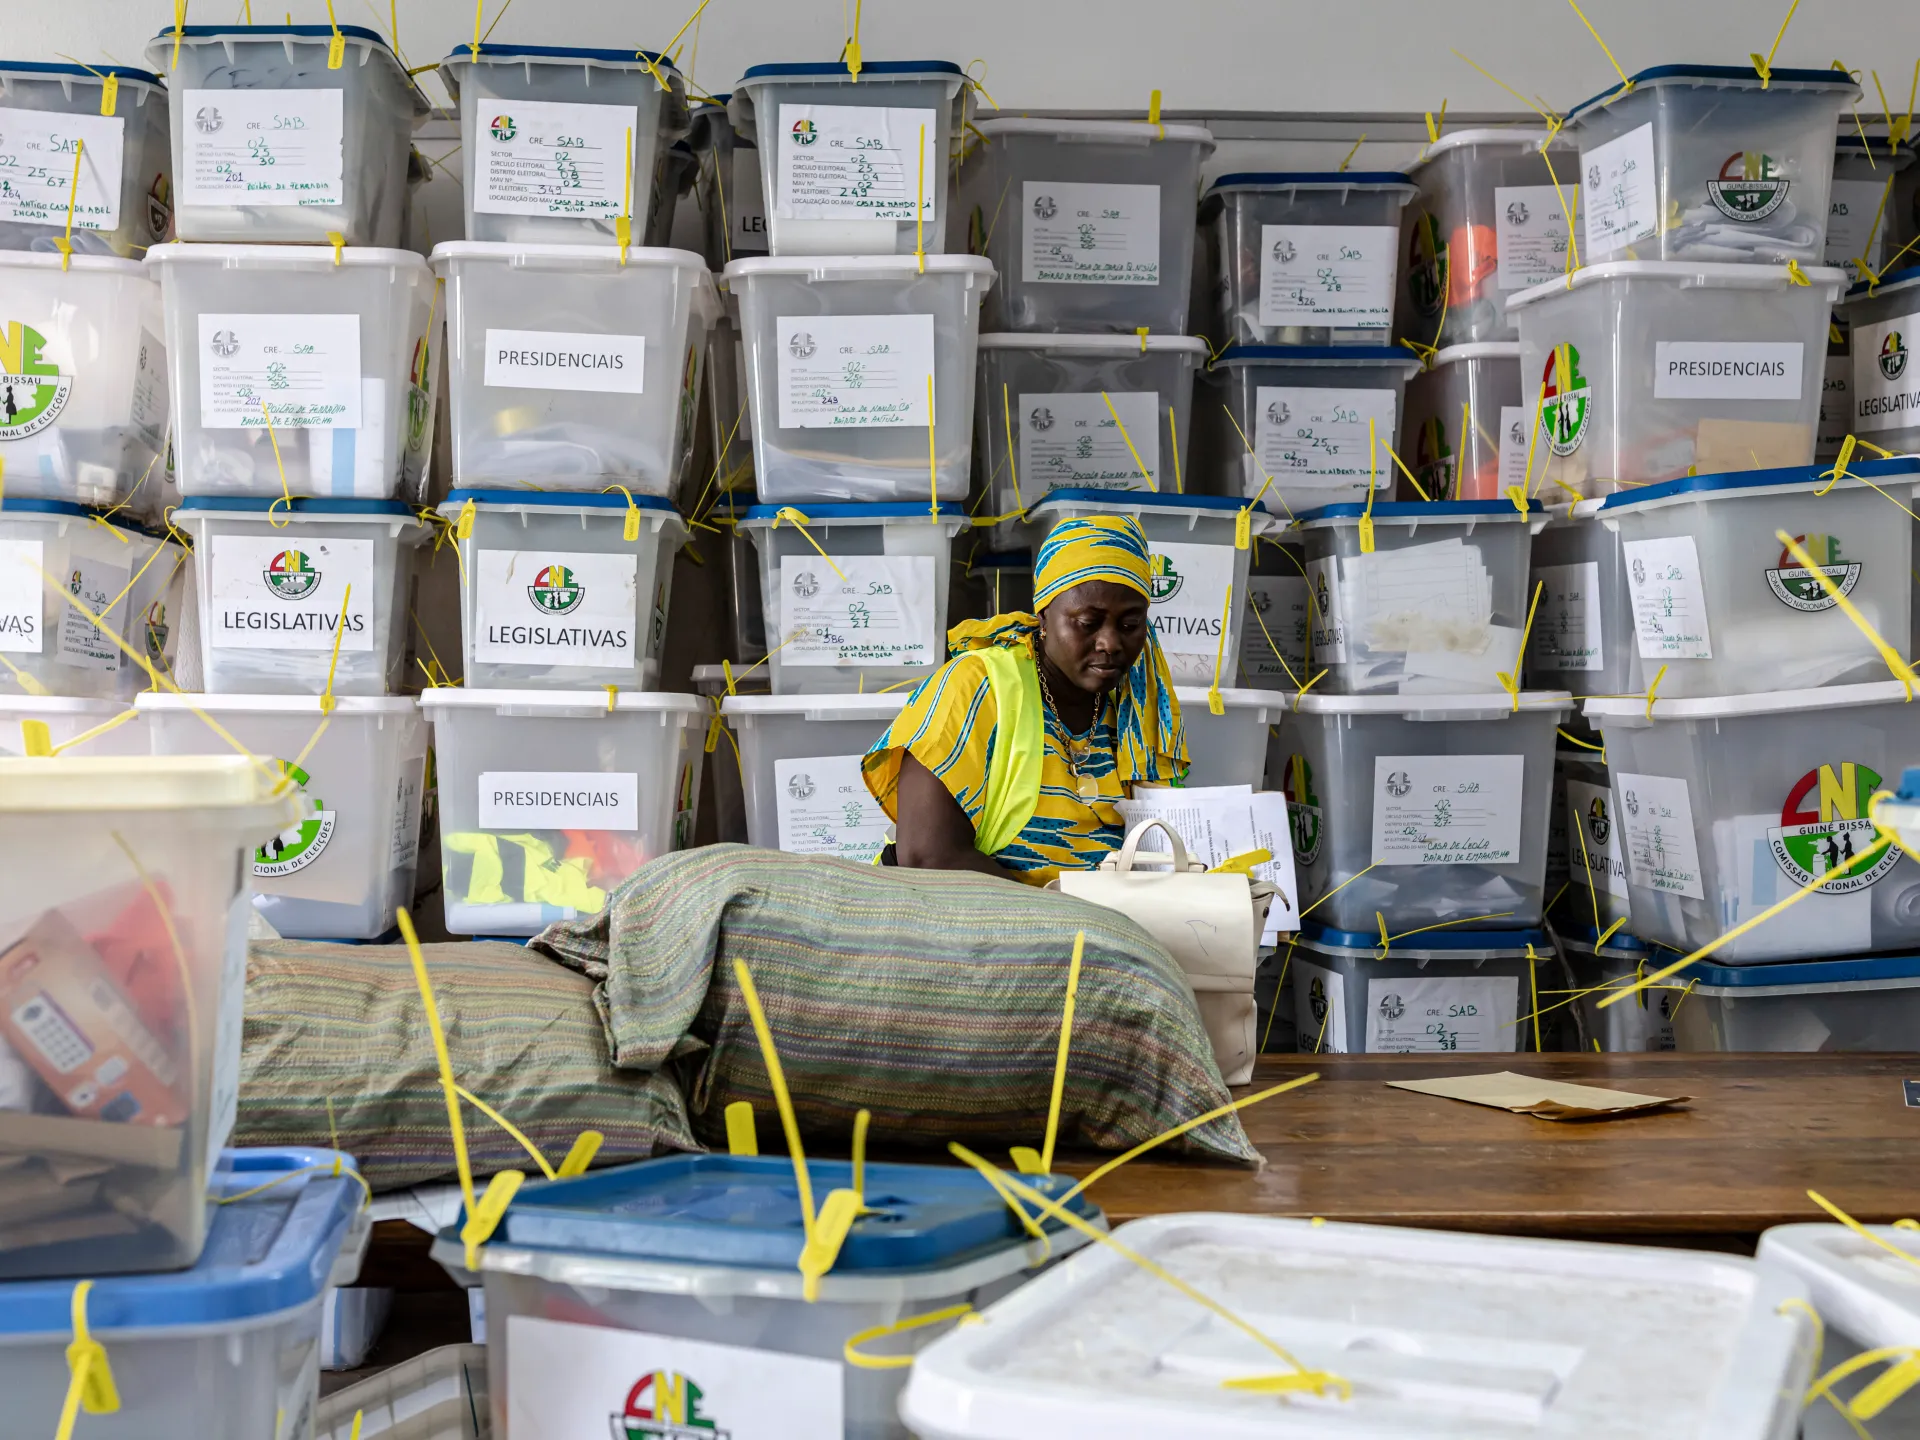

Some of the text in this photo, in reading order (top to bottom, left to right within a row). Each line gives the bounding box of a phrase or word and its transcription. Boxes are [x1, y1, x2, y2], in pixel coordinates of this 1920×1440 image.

[273, 115, 305, 129] SAB
[50, 134, 84, 154] SAB
[248, 137, 268, 149] 02
[556, 136, 584, 148] SAB
[856, 137, 883, 150] SAB
[252, 148, 270, 158] 25
[555, 152, 572, 160] 02
[851, 155, 867, 163] 02
[259, 157, 275, 166] 30
[557, 162, 576, 171] 25
[1719, 151, 1780, 181] CNE
[28, 167, 47, 177] 25
[216, 164, 232, 173] 02
[858, 164, 873, 173] 25
[47, 177, 66, 187] 67
[226, 173, 244, 182] 201
[863, 173, 879, 181] 04
[537, 185, 562, 195] 349
[840, 187, 868, 197] 249
[489, 195, 528, 203] LOCALIZAÇÃO
[1729, 210, 1758, 220] NACIONAL
[1340, 246, 1362, 260] SAB
[1317, 268, 1333, 278] 02
[1321, 276, 1337, 284] 25
[0, 320, 59, 374] NE
[293, 344, 314, 354] SAB
[867, 345, 890, 354] SAB
[498, 350, 624, 369] PRESIDENCIAIS
[1543, 342, 1586, 398] CNE
[1669, 362, 1785, 377] PRESIDENCIAIS
[3, 375, 41, 385] BISSAU
[245, 397, 261, 405] 201
[1860, 391, 1920, 417] LEGISLATIVA
[24, 386, 67, 433] DE ELEIÇÕES
[1331, 406, 1358, 423] SAB
[1297, 429, 1313, 438] 02
[1312, 438, 1328, 447] 25
[1553, 443, 1574, 453] NACIONAL
[1574, 437, 1580, 446] DE
[1326, 446, 1340, 455] 45
[1779, 533, 1850, 568] CNE
[270, 550, 315, 572] CNE
[1150, 554, 1177, 576] NE
[534, 565, 578, 588] CNE
[1667, 565, 1683, 580] SAB
[867, 582, 892, 595] SAB
[1769, 565, 1858, 610] COMISSÃO NACIONAL LEIÇÕES
[849, 602, 867, 612] 02
[224, 611, 364, 632] LEGISLATIVAS
[850, 612, 870, 620] 25
[1154, 616, 1221, 636] ATIVAS
[489, 626, 627, 648] LEGISLATIVAS
[1458, 783, 1480, 793] SAB
[494, 791, 619, 806] PRESIDENCIAIS
[1781, 762, 1883, 827] CNE
[1800, 820, 1873, 835] GUINÉ BISSA
[254, 820, 332, 873] CIONAL DE ELEIÇÕES
[1572, 848, 1626, 880] LEGISLATIVA
[1773, 840, 1809, 882] COMISSÃO
[1865, 870, 1879, 882] DE
[1449, 1005, 1477, 1017] SAB
[1426, 1023, 1447, 1034] 02
[1438, 1032, 1459, 1042] 25
[624, 1370, 715, 1429] CNE
